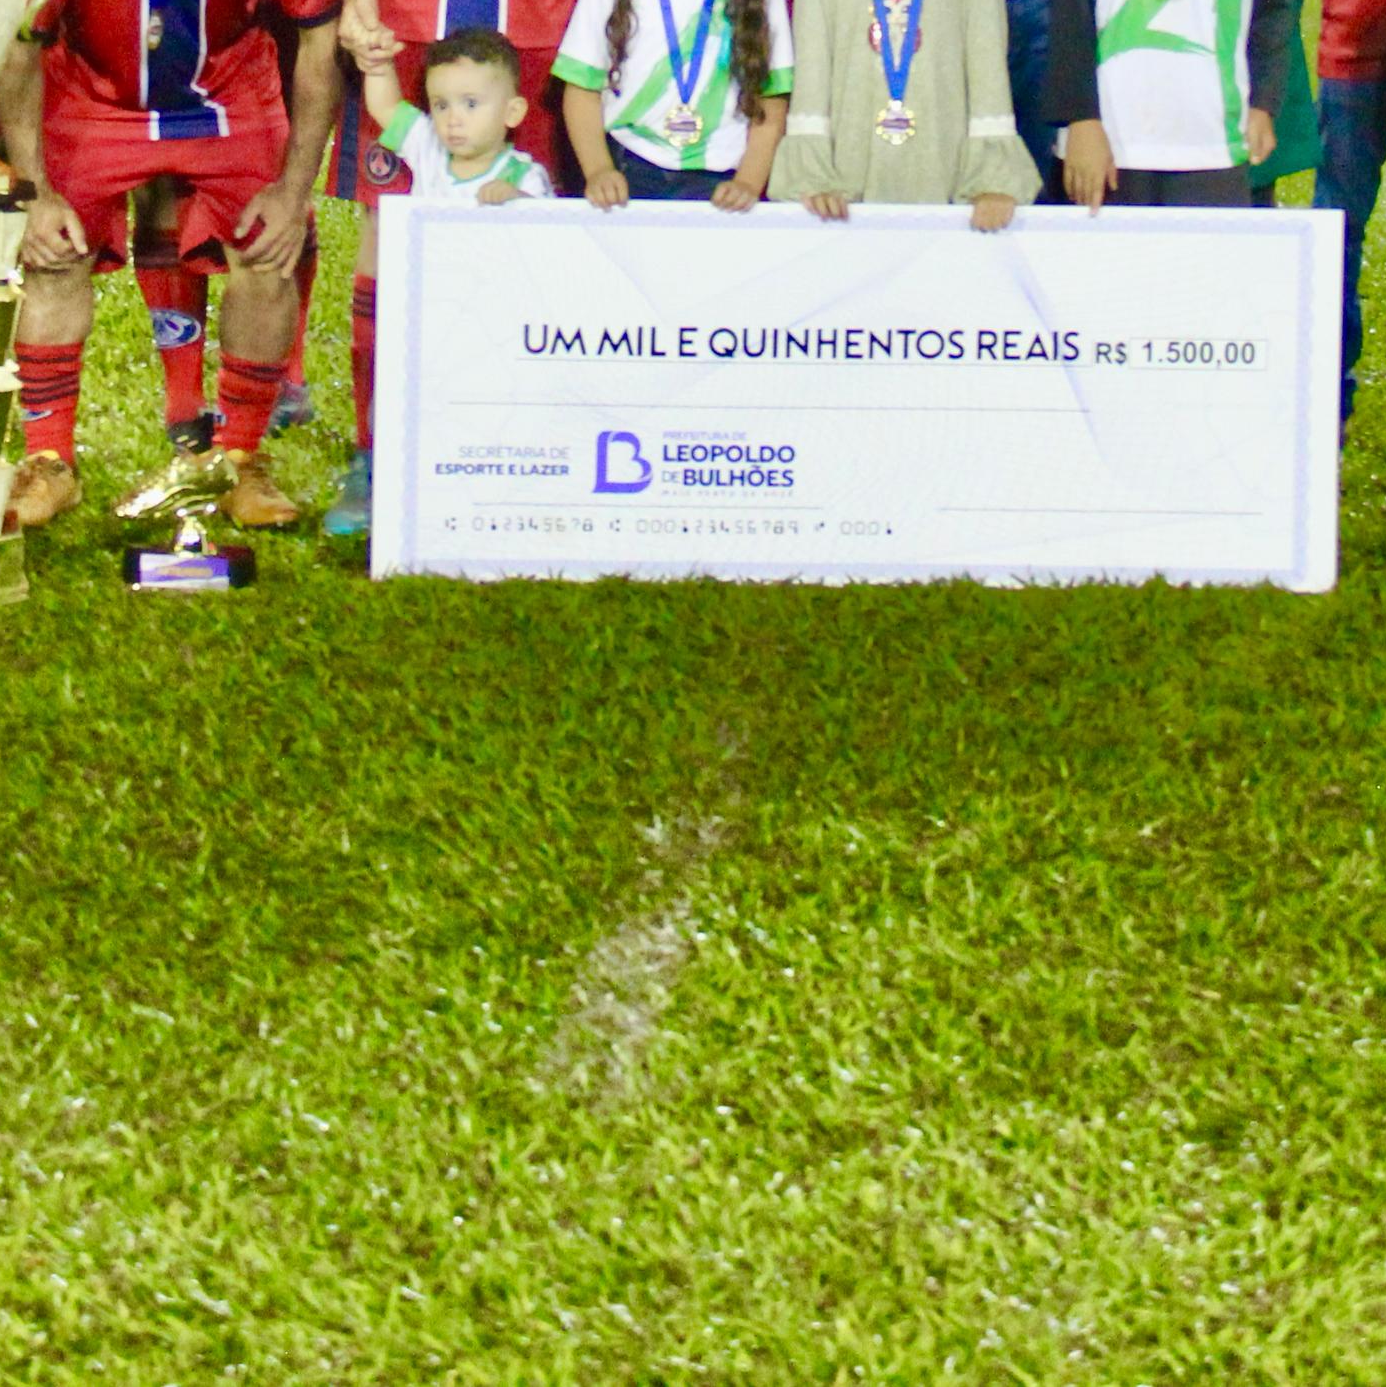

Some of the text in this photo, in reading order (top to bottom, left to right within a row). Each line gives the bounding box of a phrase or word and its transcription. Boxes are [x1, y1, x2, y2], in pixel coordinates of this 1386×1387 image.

[523, 324, 1256, 369] UM MIL E QUINHENTOS REAIS R$ 1.500,00
[458, 446, 571, 460] SECRETARIA DE
[662, 444, 796, 464] LEOPOLDO
[434, 463, 571, 477] ESPORTE E LAZER
[662, 465, 795, 488] DE BULHÕES
